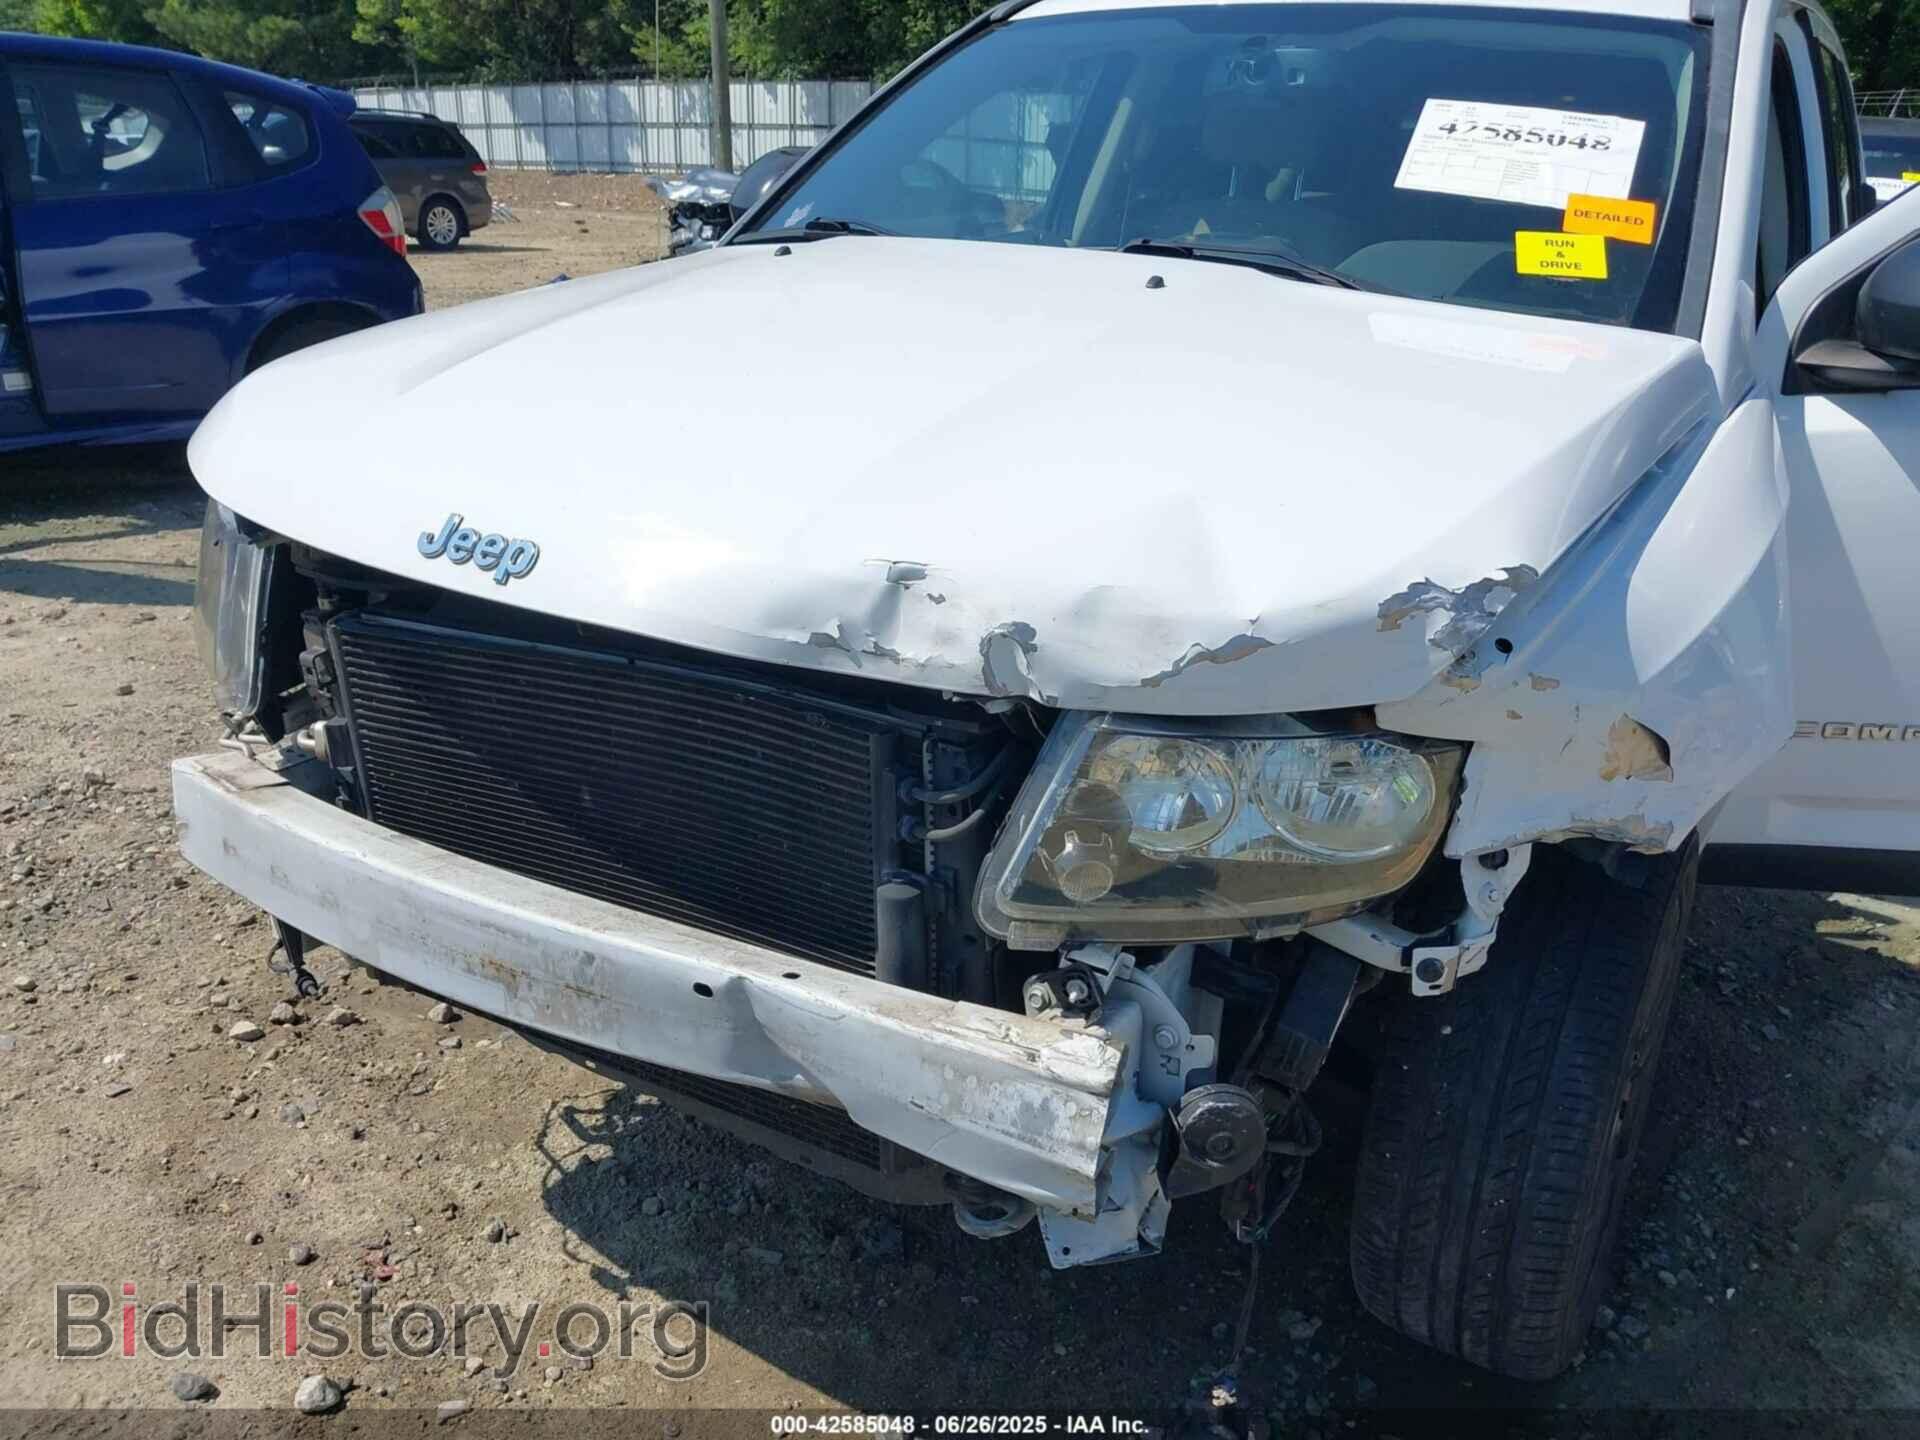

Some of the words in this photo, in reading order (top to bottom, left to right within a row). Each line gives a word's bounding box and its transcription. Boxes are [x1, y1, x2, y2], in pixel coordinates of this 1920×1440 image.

[1573, 208, 1645, 226] DETAILED
[1544, 238, 1575, 249] RUN
[1556, 250, 1566, 259] &
[1539, 260, 1583, 271] DRIVE
[417, 512, 540, 586] Jeep
